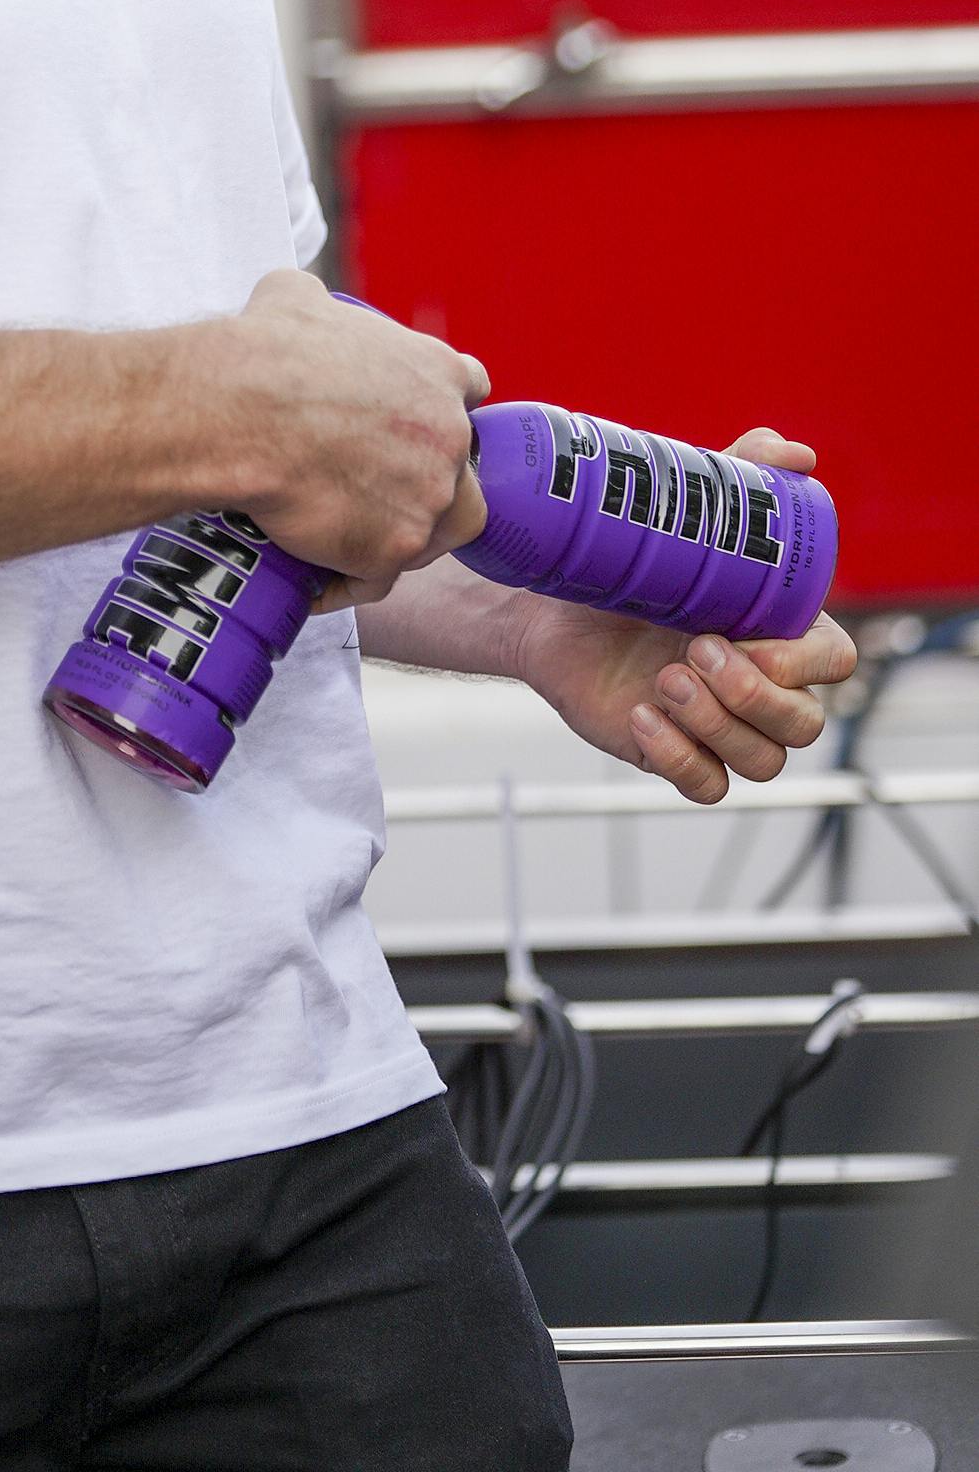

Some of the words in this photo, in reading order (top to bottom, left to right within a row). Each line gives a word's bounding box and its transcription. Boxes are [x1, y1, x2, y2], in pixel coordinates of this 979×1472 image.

[519, 416, 537, 467] GRAPE
[538, 405, 785, 569] PRIME
[808, 511, 816, 525] OZ
[783, 492, 803, 588] HYDRATION
[808, 529, 815, 542] FL
[93, 510, 270, 684] IME
